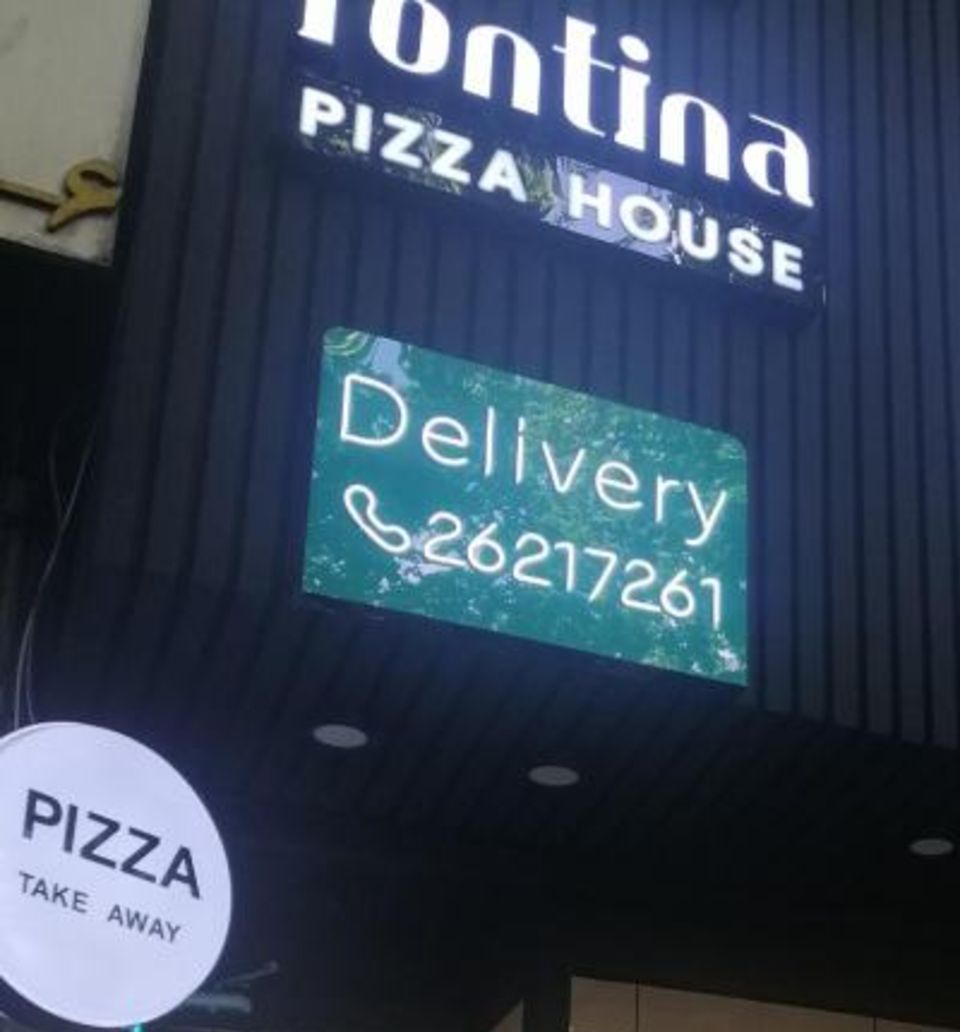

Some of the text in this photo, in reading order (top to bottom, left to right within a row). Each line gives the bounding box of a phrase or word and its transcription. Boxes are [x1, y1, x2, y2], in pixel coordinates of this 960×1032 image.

[300, 85, 806, 293] PIZZA HOUSE
[340, 372, 729, 546] Delivery
[424, 511, 723, 630] 26217261
[22, 788, 203, 900] PIZZA
[18, 870, 182, 943] TAKE AWAY
